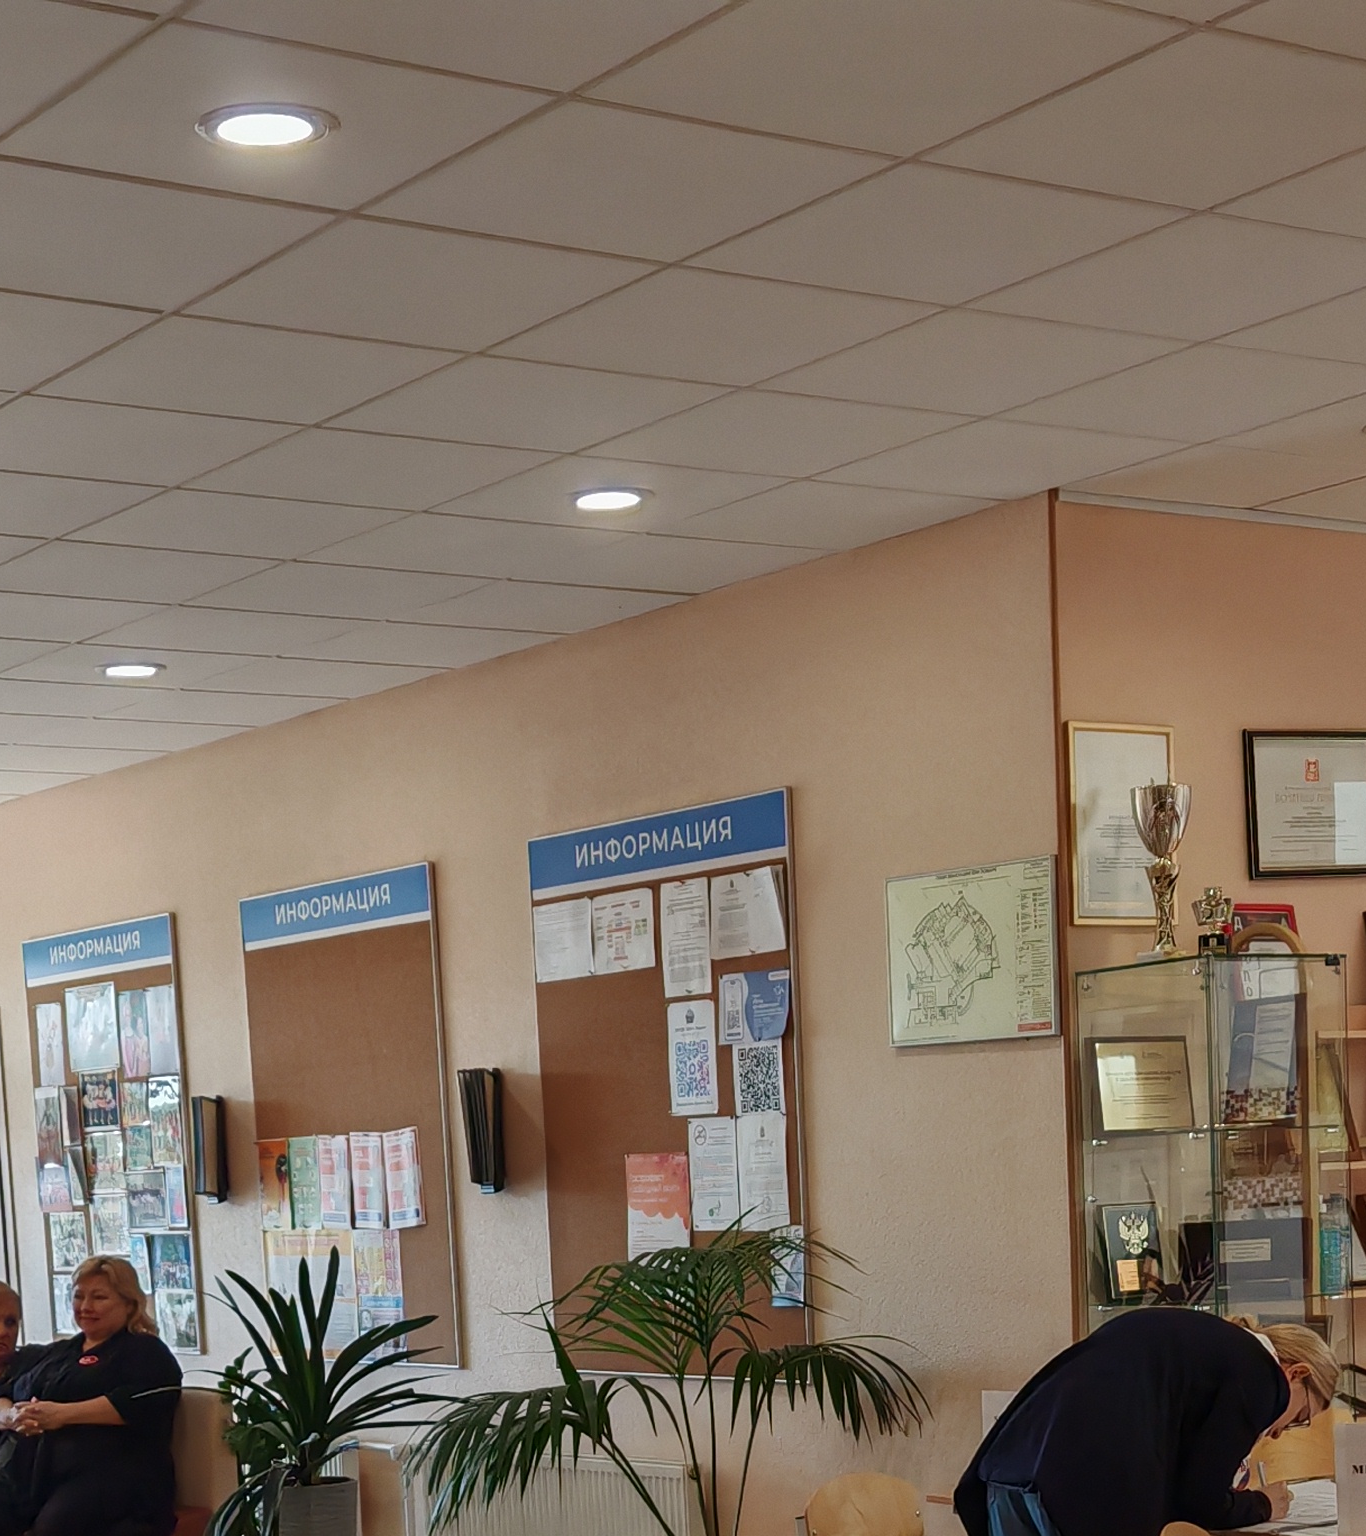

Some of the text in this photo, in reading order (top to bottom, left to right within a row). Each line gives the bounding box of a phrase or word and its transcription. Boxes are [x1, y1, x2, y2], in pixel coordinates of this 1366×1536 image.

[575, 815, 733, 869] ИНФОРМАЦИЯ
[275, 883, 391, 925] ИНФОРМАЦИЯ
[49, 930, 141, 965] ИНФОРМАЦИЯ
